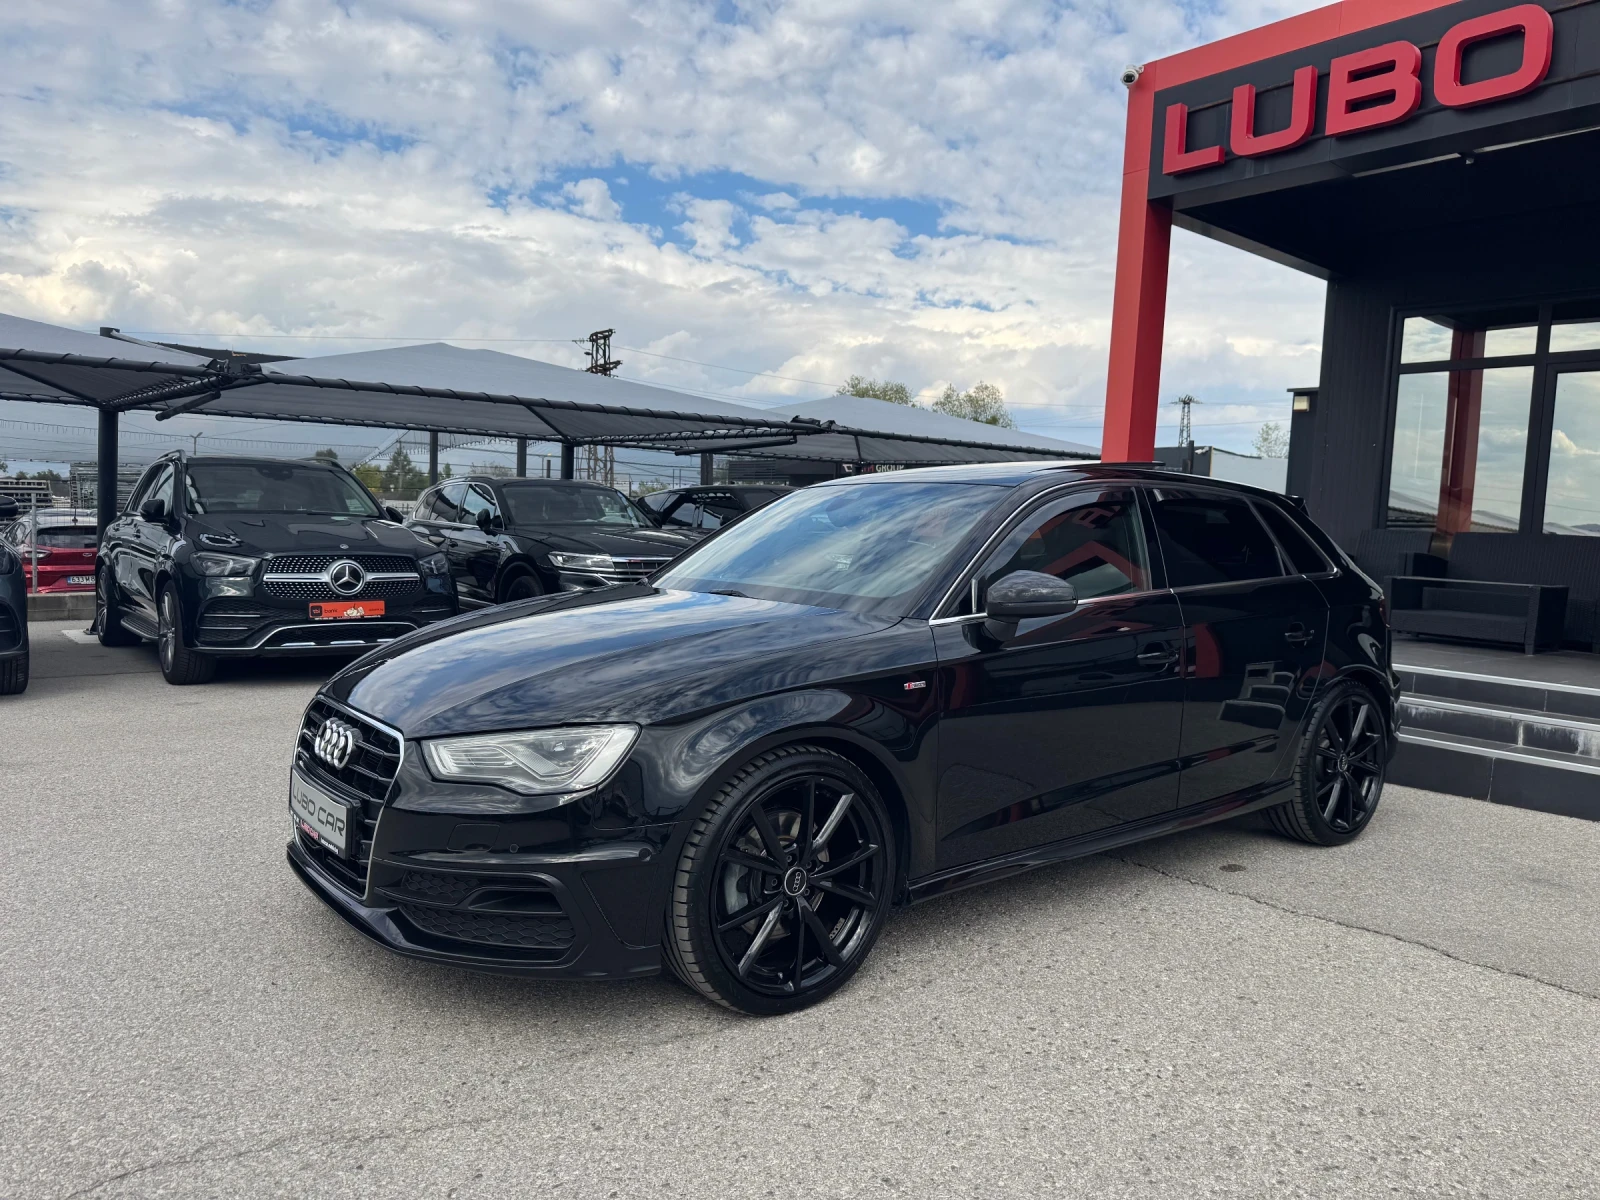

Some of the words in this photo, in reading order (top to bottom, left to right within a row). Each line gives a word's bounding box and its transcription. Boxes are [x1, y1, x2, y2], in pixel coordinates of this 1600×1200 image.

[1163, 4, 1554, 175] LUBO
[292, 783, 316, 816] LUBO
[317, 806, 346, 837] CAR
